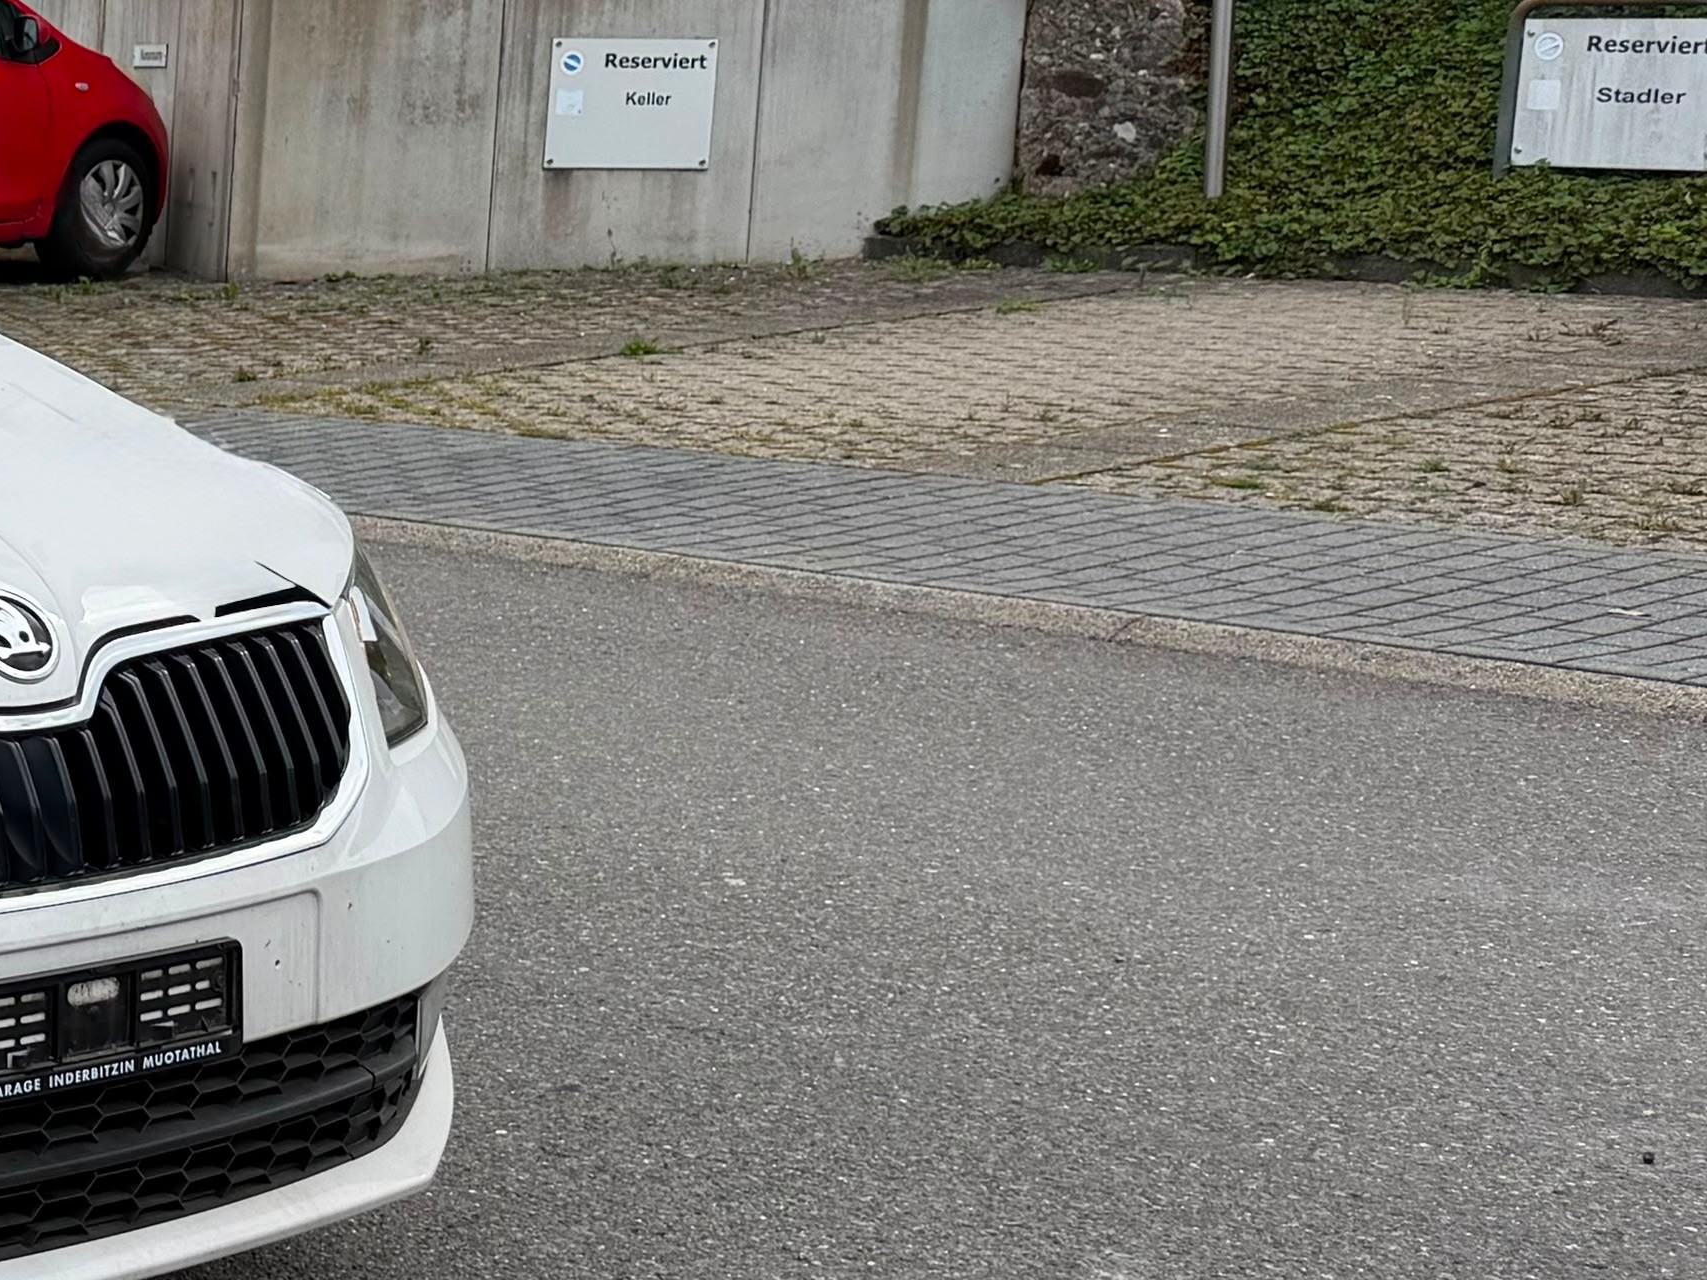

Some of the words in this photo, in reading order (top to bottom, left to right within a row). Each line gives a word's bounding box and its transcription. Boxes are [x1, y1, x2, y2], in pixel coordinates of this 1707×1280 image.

[604, 52, 708, 70] Reserviert
[625, 91, 673, 107] Keller
[1596, 86, 1687, 105] Stadler
[48, 1059, 136, 1089] INDERBITZIN
[142, 1041, 222, 1070] MUOTATHAL
